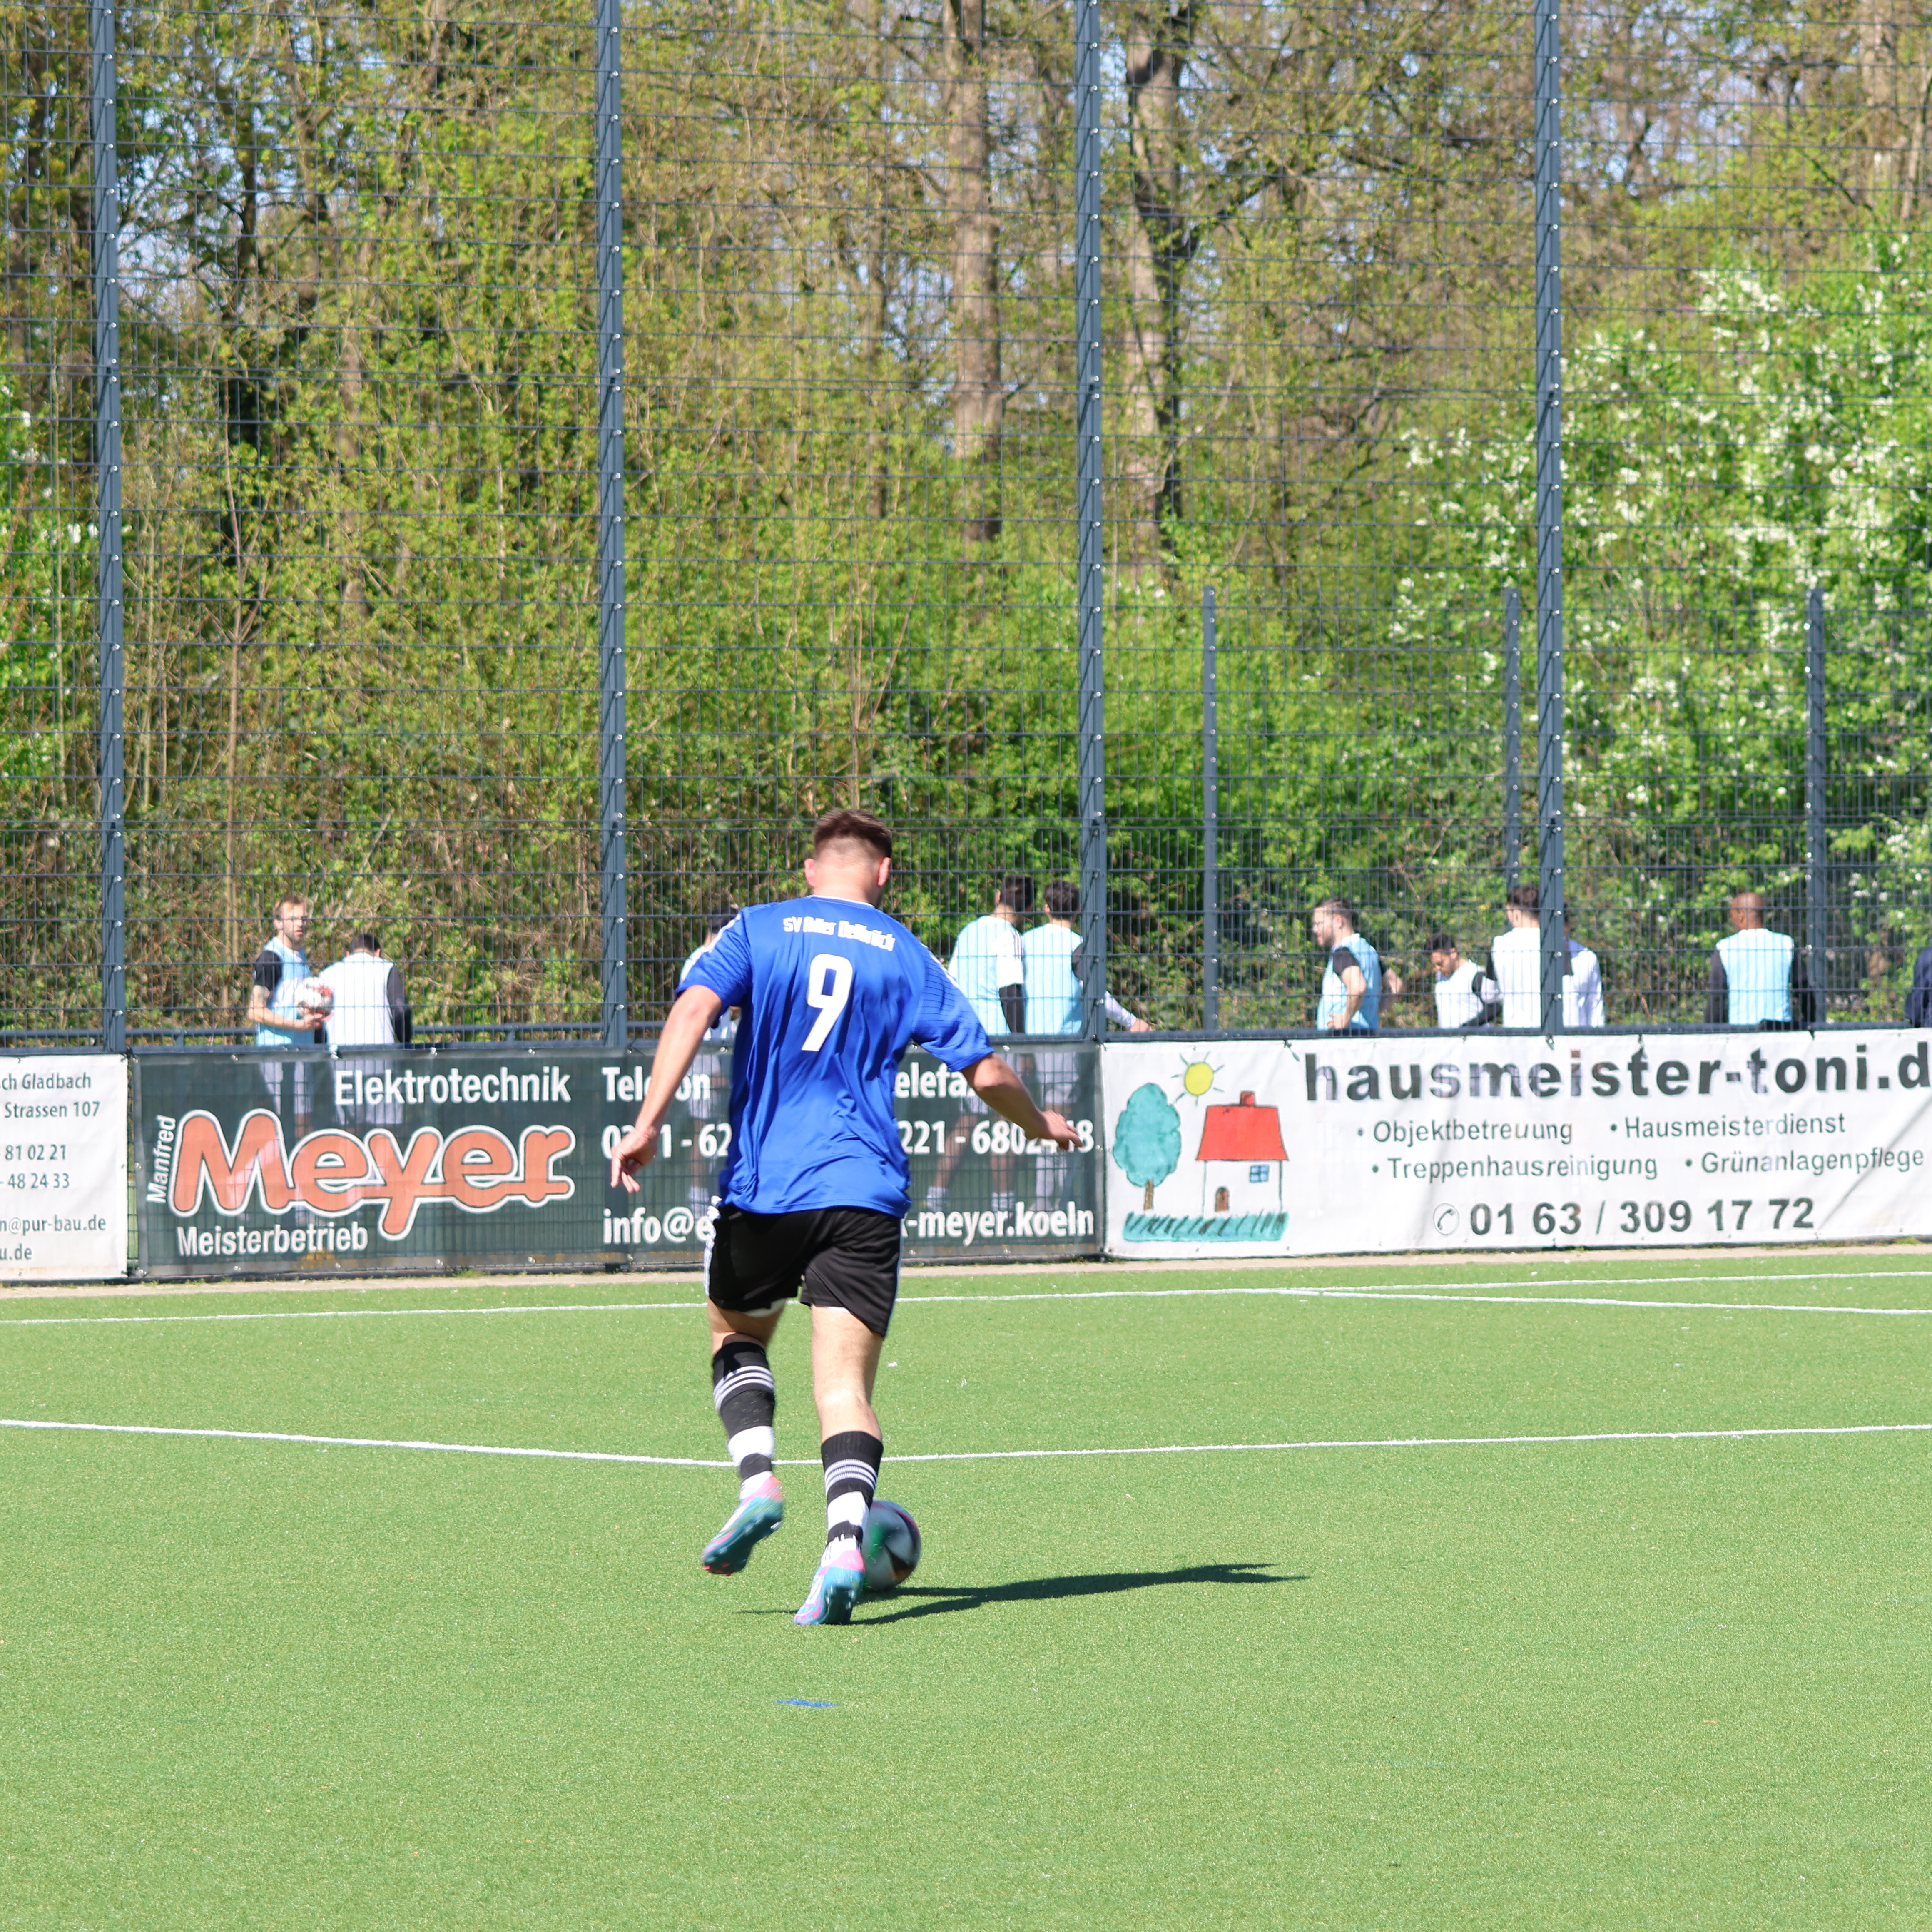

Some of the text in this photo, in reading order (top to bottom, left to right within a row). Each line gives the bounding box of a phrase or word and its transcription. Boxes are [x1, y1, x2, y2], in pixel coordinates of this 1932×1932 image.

[783, 916, 803, 933] SV
[801, 954, 853, 1051] 9
[0, 1072, 92, 1090] ch Gladbach
[335, 1066, 572, 1105] Elektrotechnik
[602, 1066, 710, 1102] Telon
[895, 1062, 976, 1098] elefa
[4, 1101, 100, 1118] Strassen 107
[898, 1120, 945, 1154] 221
[1374, 1120, 1573, 1148] Objektbetreuung
[1626, 1113, 1846, 1138] Hausmeisterdienst
[5, 1144, 66, 1160] 81 02 21
[146, 1115, 176, 1203] Manfred
[1701, 1147, 1925, 1176] Grünanlagenpflege
[8, 1173, 26, 1189] 48
[31, 1173, 49, 1188] 24
[53, 1173, 70, 1188] 33
[168, 1108, 577, 1241] Meyer
[1387, 1155, 1658, 1184] Treppenhausreinigung
[1470, 1203, 1514, 1235] 01
[1533, 1202, 1581, 1235] 63
[1620, 1200, 1692, 1233] 309
[1707, 1199, 1753, 1231] 17
[1768, 1198, 1815, 1229] 72
[176, 1223, 368, 1256] Meisterbetrieb
